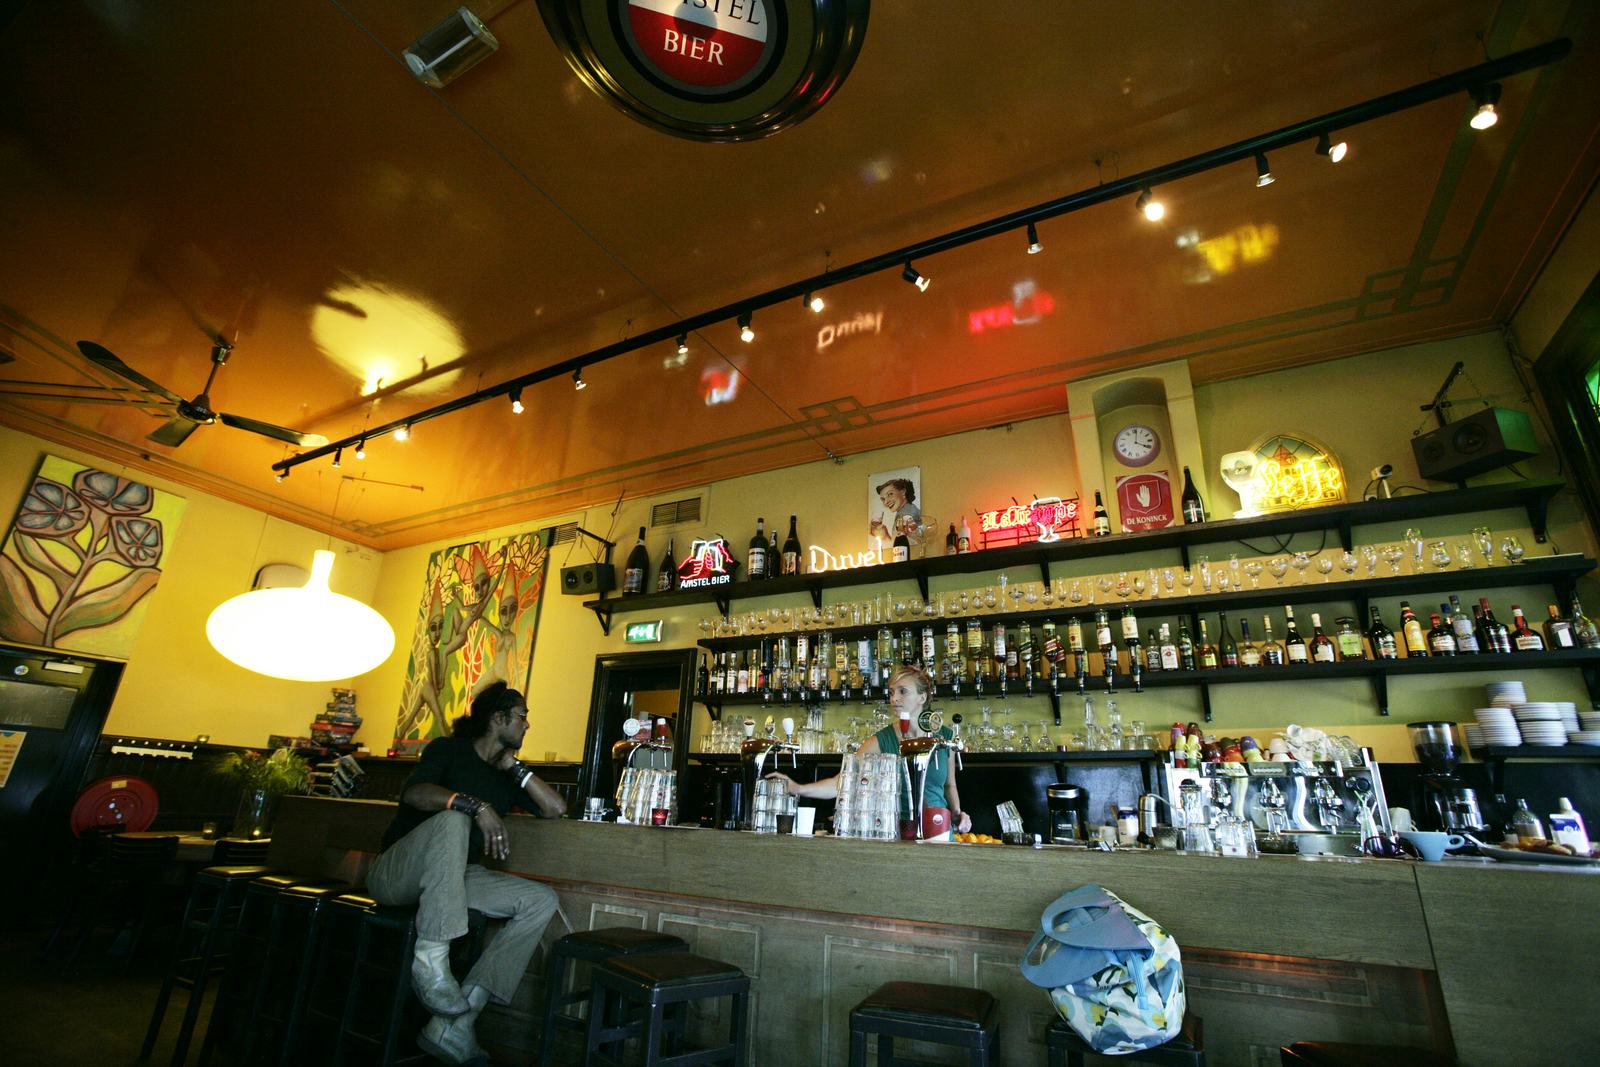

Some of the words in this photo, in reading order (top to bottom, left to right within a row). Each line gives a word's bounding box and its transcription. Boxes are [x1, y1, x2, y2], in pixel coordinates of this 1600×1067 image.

[663, 28, 724, 66] BIER
[1257, 453, 1342, 502] Leffe
[1136, 514, 1168, 524] KONINCK
[809, 535, 885, 573] Duvel
[680, 577, 710, 589] AMSTEL
[711, 574, 730, 586] BIER
